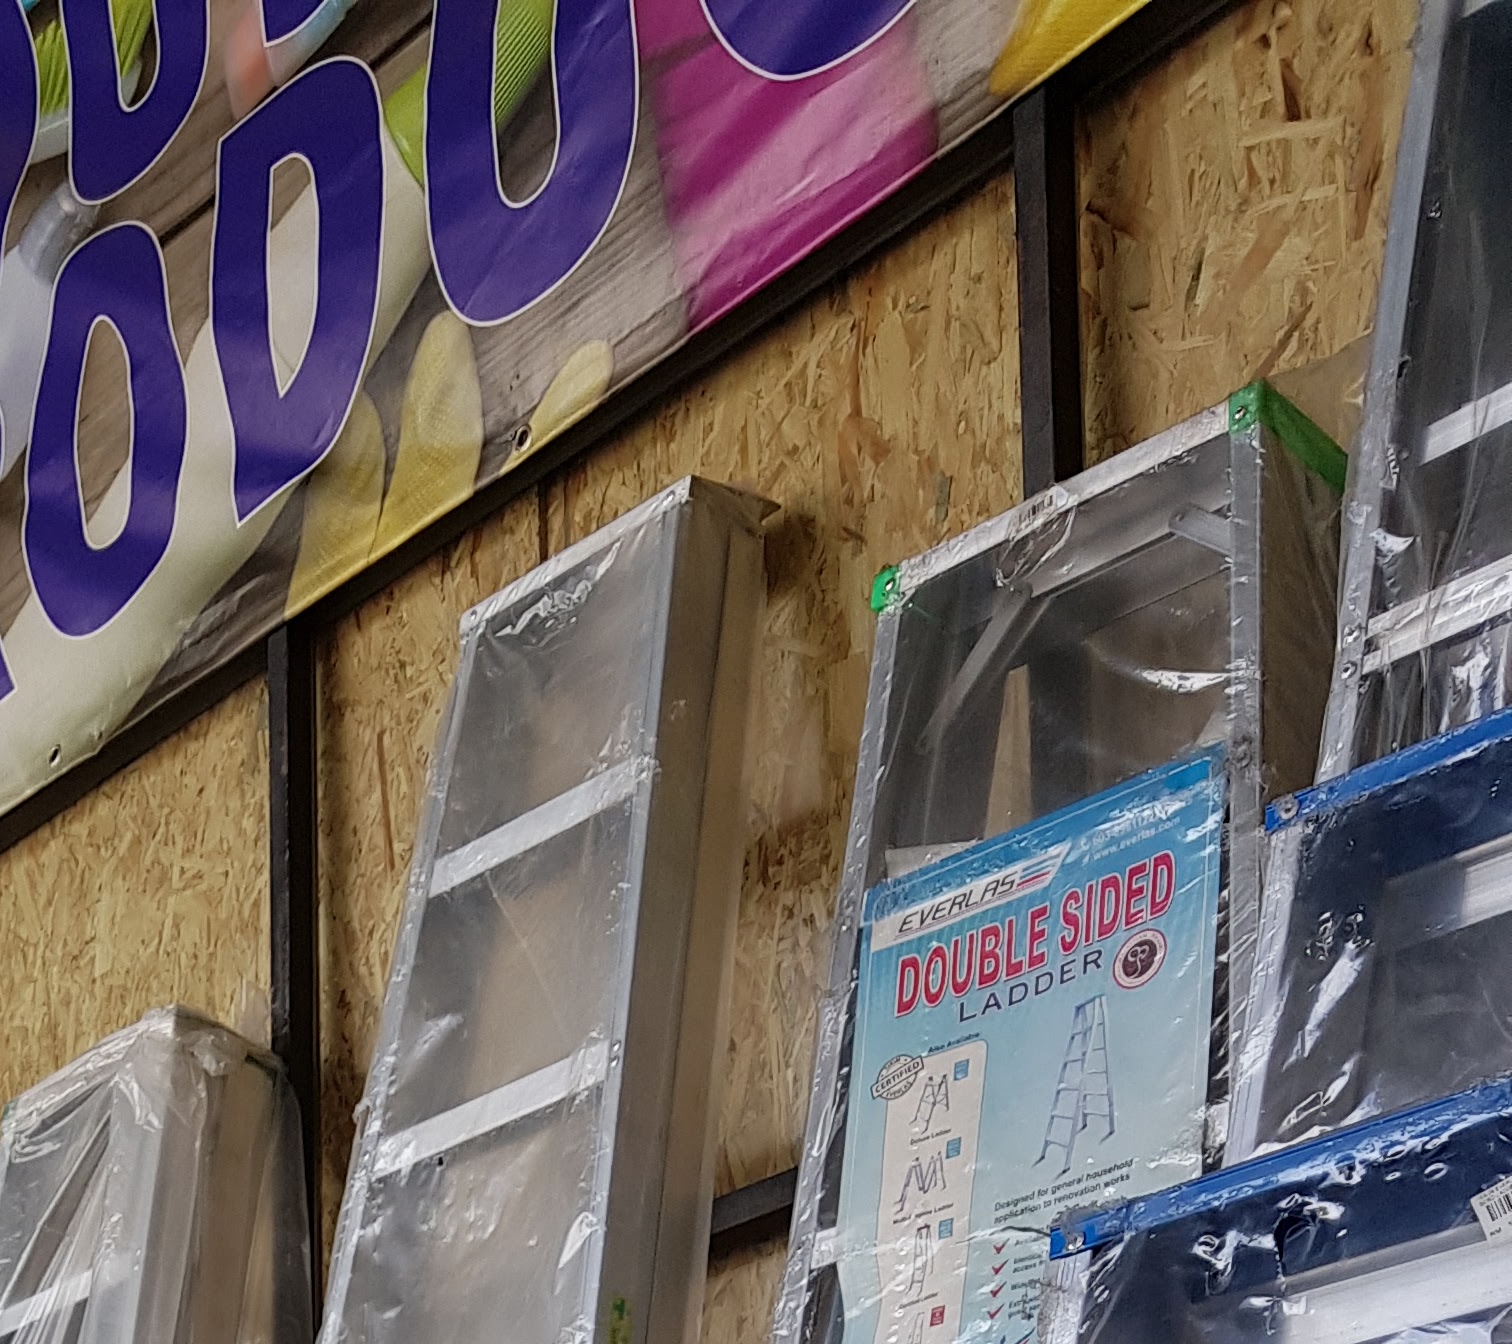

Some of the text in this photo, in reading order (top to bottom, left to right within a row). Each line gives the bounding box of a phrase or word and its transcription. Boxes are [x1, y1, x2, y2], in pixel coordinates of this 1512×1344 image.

[898, 869, 1018, 934] EVERLAS
[894, 902, 1050, 1018] DOUBLE
[1058, 848, 1176, 956] SIDED
[958, 949, 1104, 1024] LADDER
[874, 1061, 920, 1094] CERTIFIED
[993, 1172, 1131, 1225] application to renovation works
[994, 1158, 1135, 1212] Designed for general household
